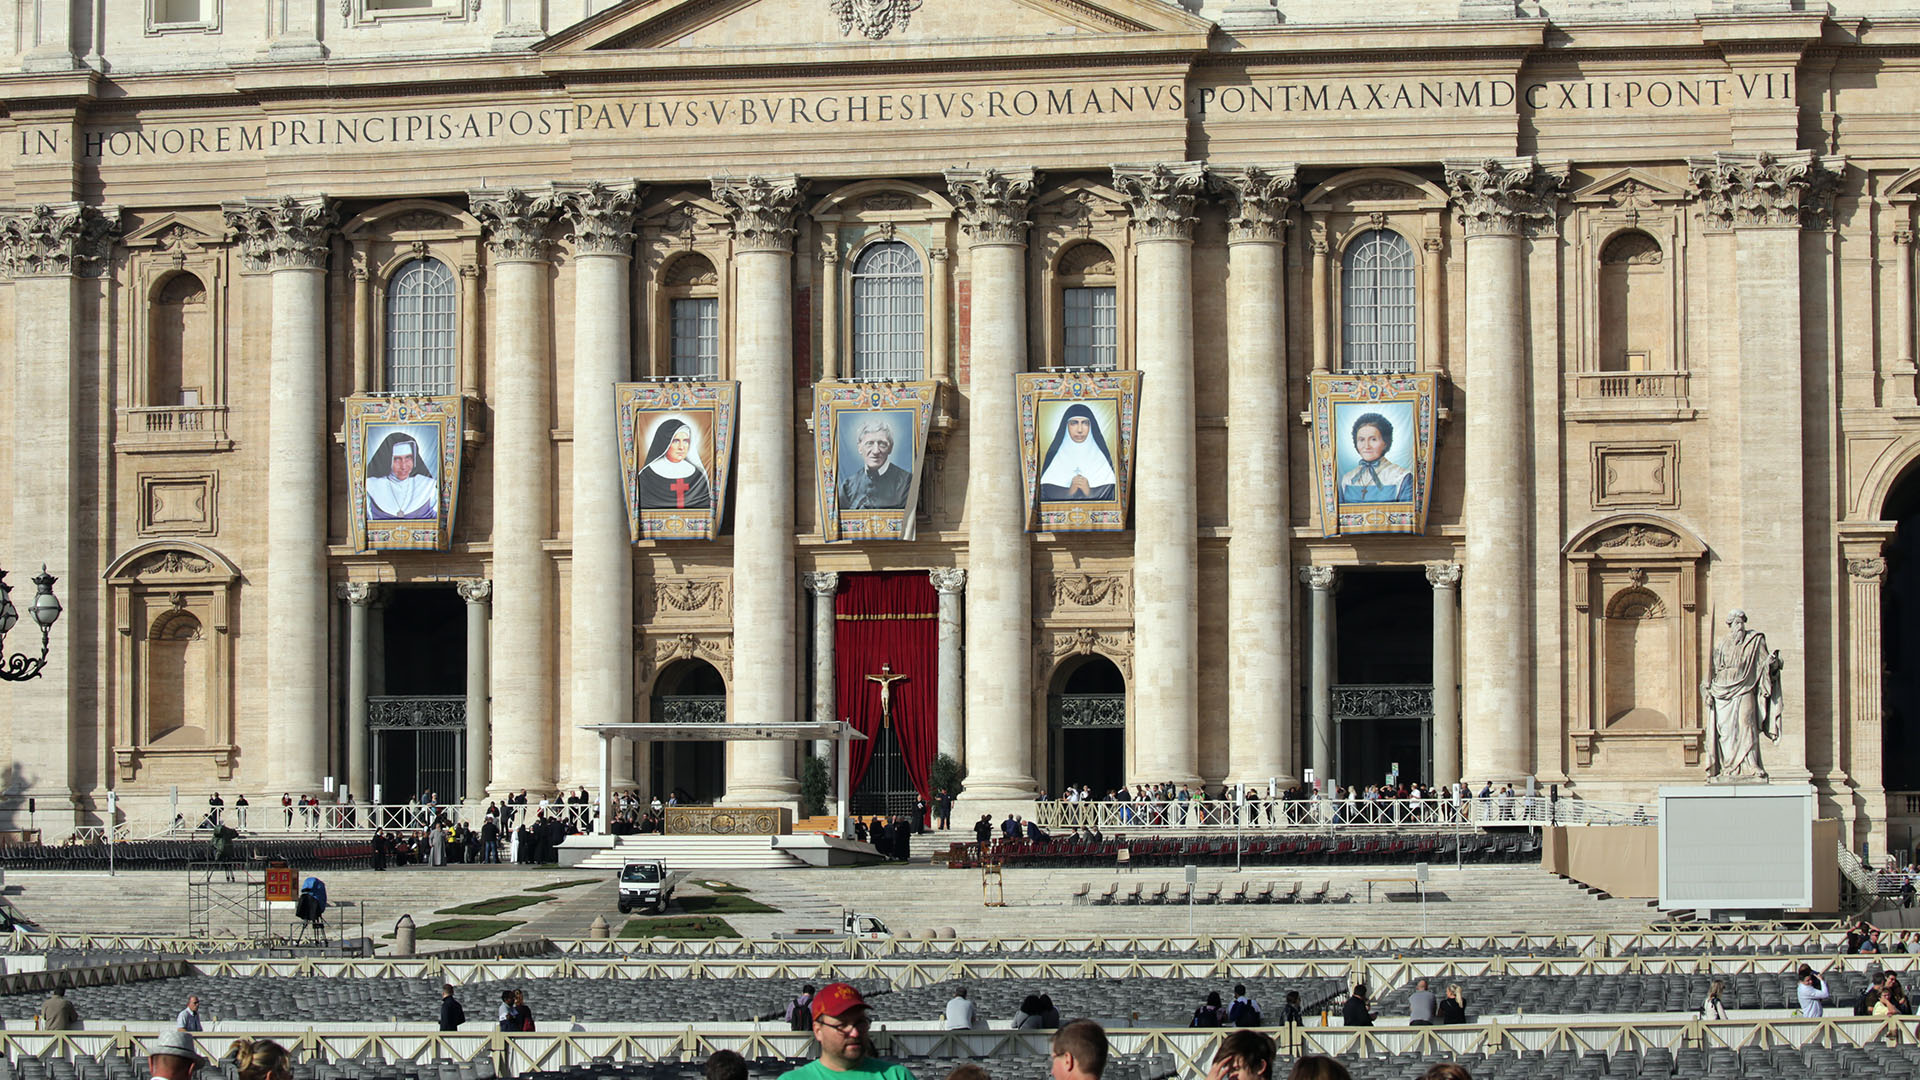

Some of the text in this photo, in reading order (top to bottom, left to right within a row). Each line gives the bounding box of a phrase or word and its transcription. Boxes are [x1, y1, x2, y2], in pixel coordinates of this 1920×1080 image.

[20, 129, 60, 155] IN
[83, 126, 264, 158] HONOREM
[270, 114, 451, 146] PRINCIPIS
[460, 108, 574, 138] APOST
[575, 100, 699, 130] PAVLVS
[706, 100, 732, 125] V
[739, 92, 974, 126] BVRGHESIVS
[986, 85, 1182, 117] ROMANVS
[1198, 85, 1298, 115] PONT
[1301, 83, 1389, 111] MAX
[1392, 82, 1444, 109] AN
[1623, 79, 1727, 109] PONT
[1735, 73, 1792, 100] VII
